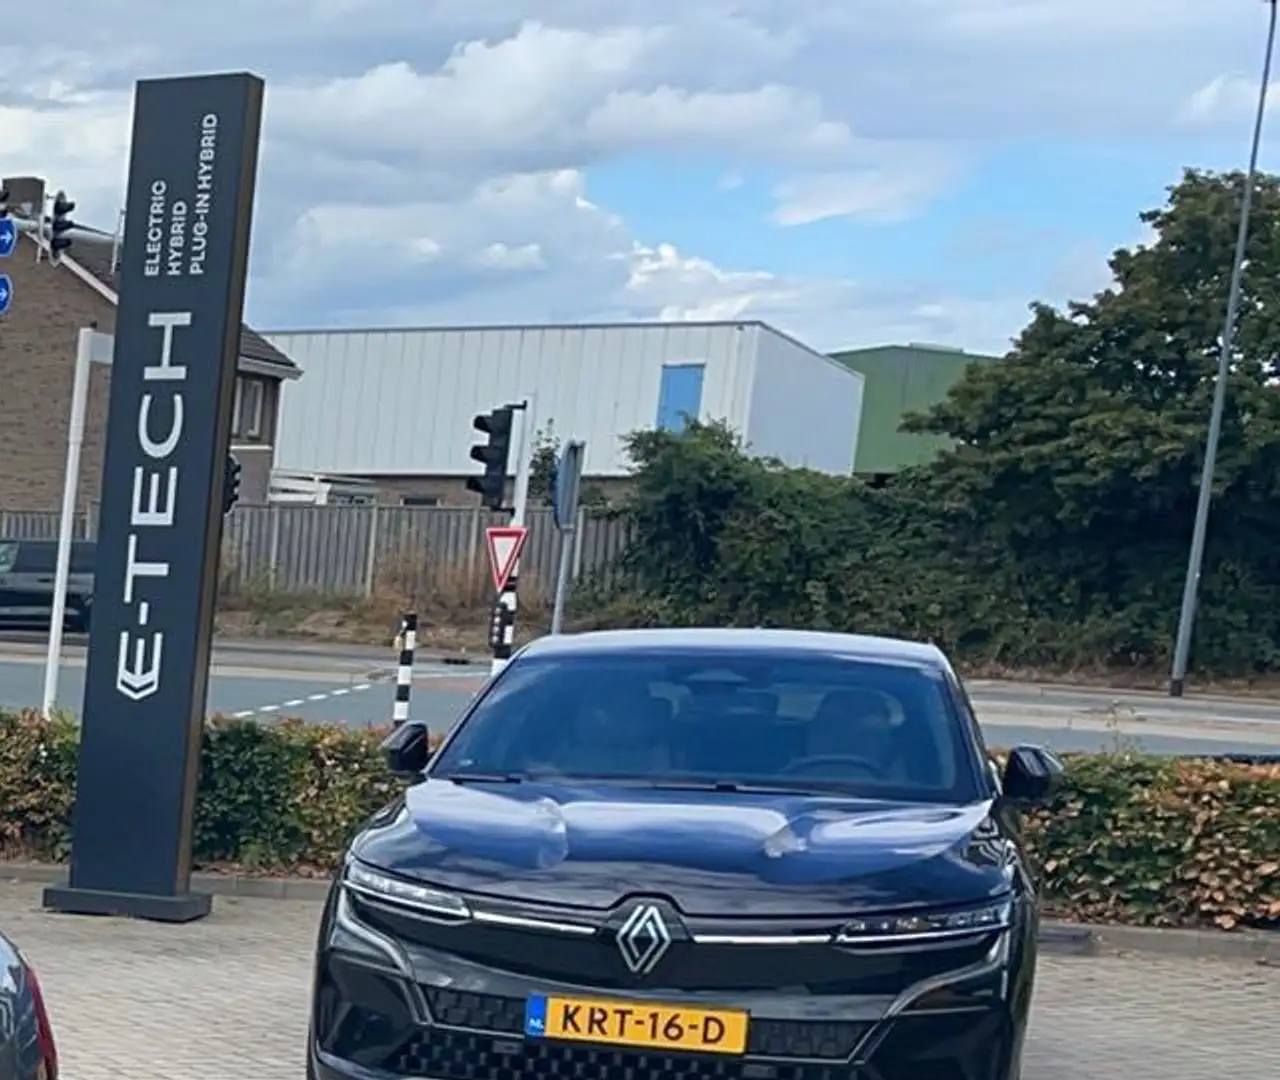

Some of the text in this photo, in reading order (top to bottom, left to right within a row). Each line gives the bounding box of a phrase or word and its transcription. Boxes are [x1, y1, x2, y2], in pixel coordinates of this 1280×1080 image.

[144, 180, 167, 277] ELECTRIC
[167, 201, 188, 276] HYBRID
[189, 113, 218, 275] PLUG-IN HYBRID
[116, 312, 192, 700] E-TECH
[561, 1003, 726, 1045] KRT-16-D
